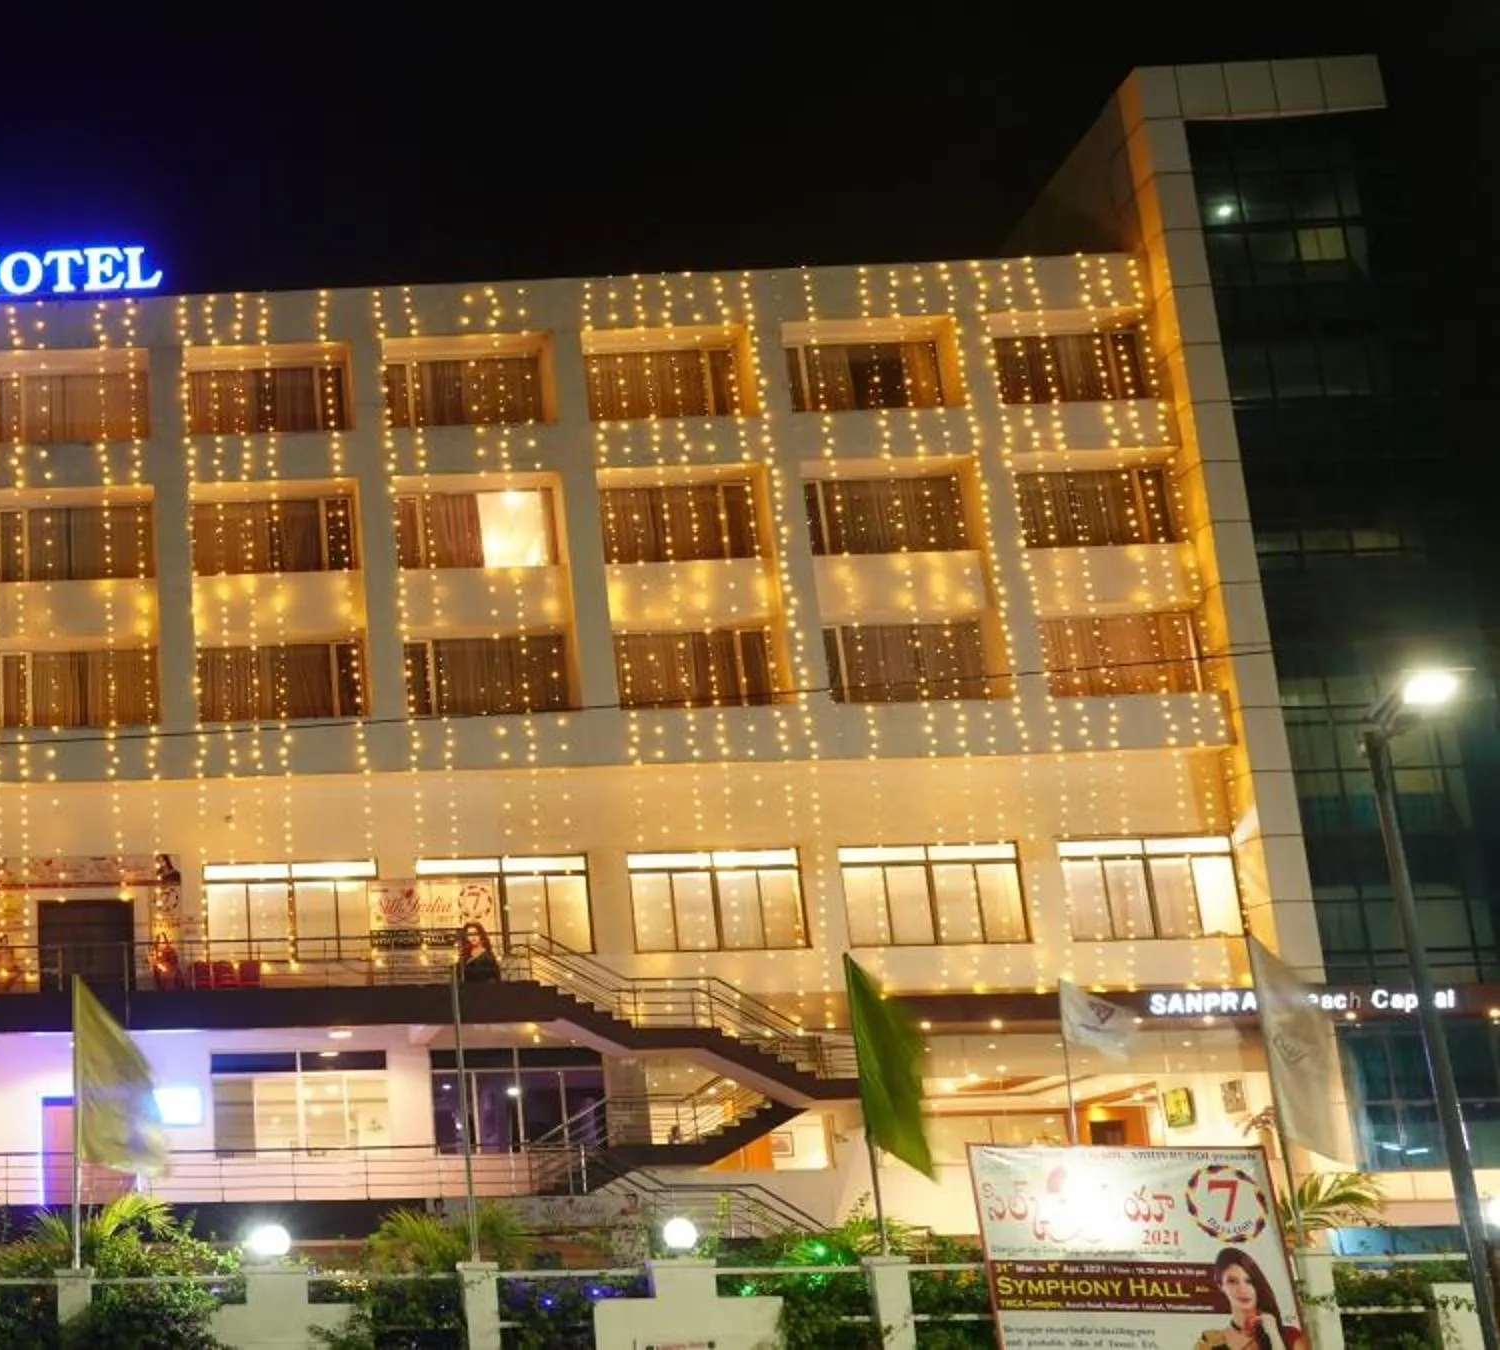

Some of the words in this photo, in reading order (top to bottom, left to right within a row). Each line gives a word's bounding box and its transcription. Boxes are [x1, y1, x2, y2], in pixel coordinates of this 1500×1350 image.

[1150, 991, 1257, 1015] SANPRA
[1371, 988, 1456, 1013] Capal
[1207, 1180, 1238, 1222] 7
[1143, 1230, 1179, 1246] 2021
[997, 1276, 1122, 1296] SYMPHONY
[1128, 1278, 1191, 1298] HALL
